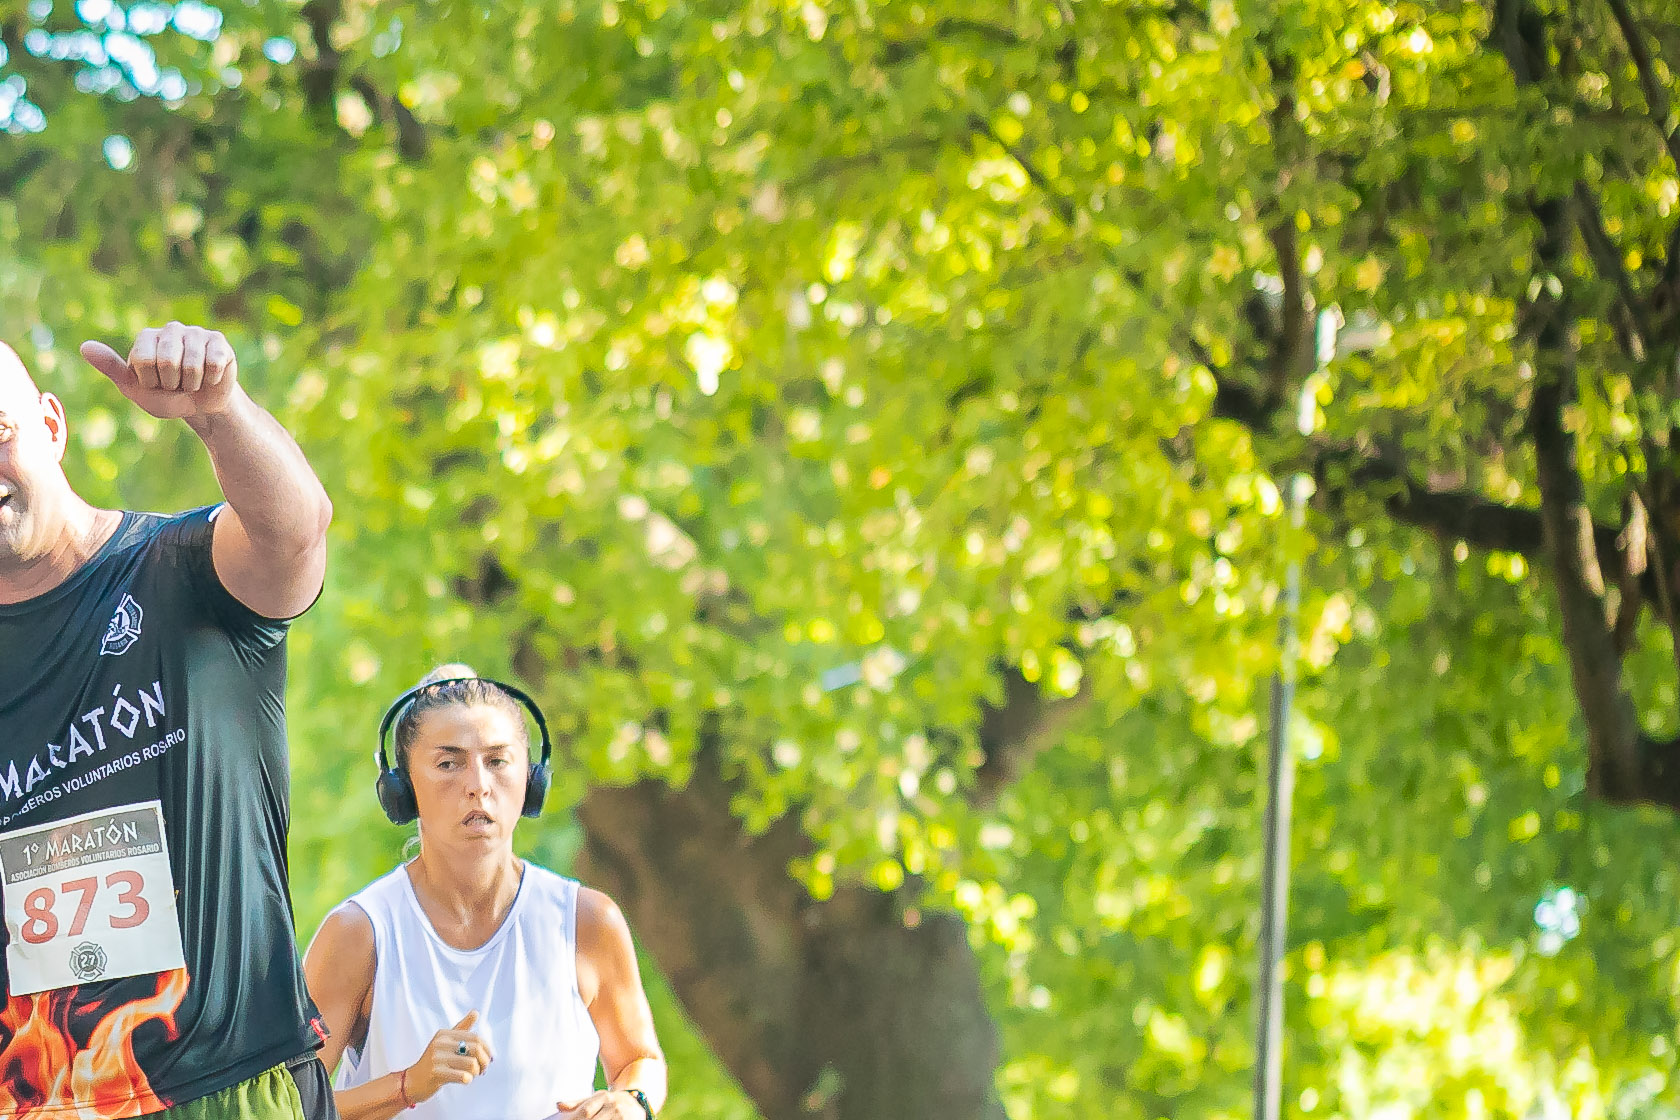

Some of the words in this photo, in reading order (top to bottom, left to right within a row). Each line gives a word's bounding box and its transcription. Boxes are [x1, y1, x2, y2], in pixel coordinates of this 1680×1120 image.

[62, 752, 141, 794] VOLUNTARIOS
[10, 865, 47, 883] ASOCIACIÓN
[47, 858, 80, 874] BOMBEROS
[80, 848, 127, 866] VOLUNTARIOS
[127, 843, 160, 857] ROSARIO
[22, 842, 40, 866] 1º
[45, 818, 139, 860] MARATÓN
[21, 870, 150, 945] 873
[80, 954, 97, 968] 27
